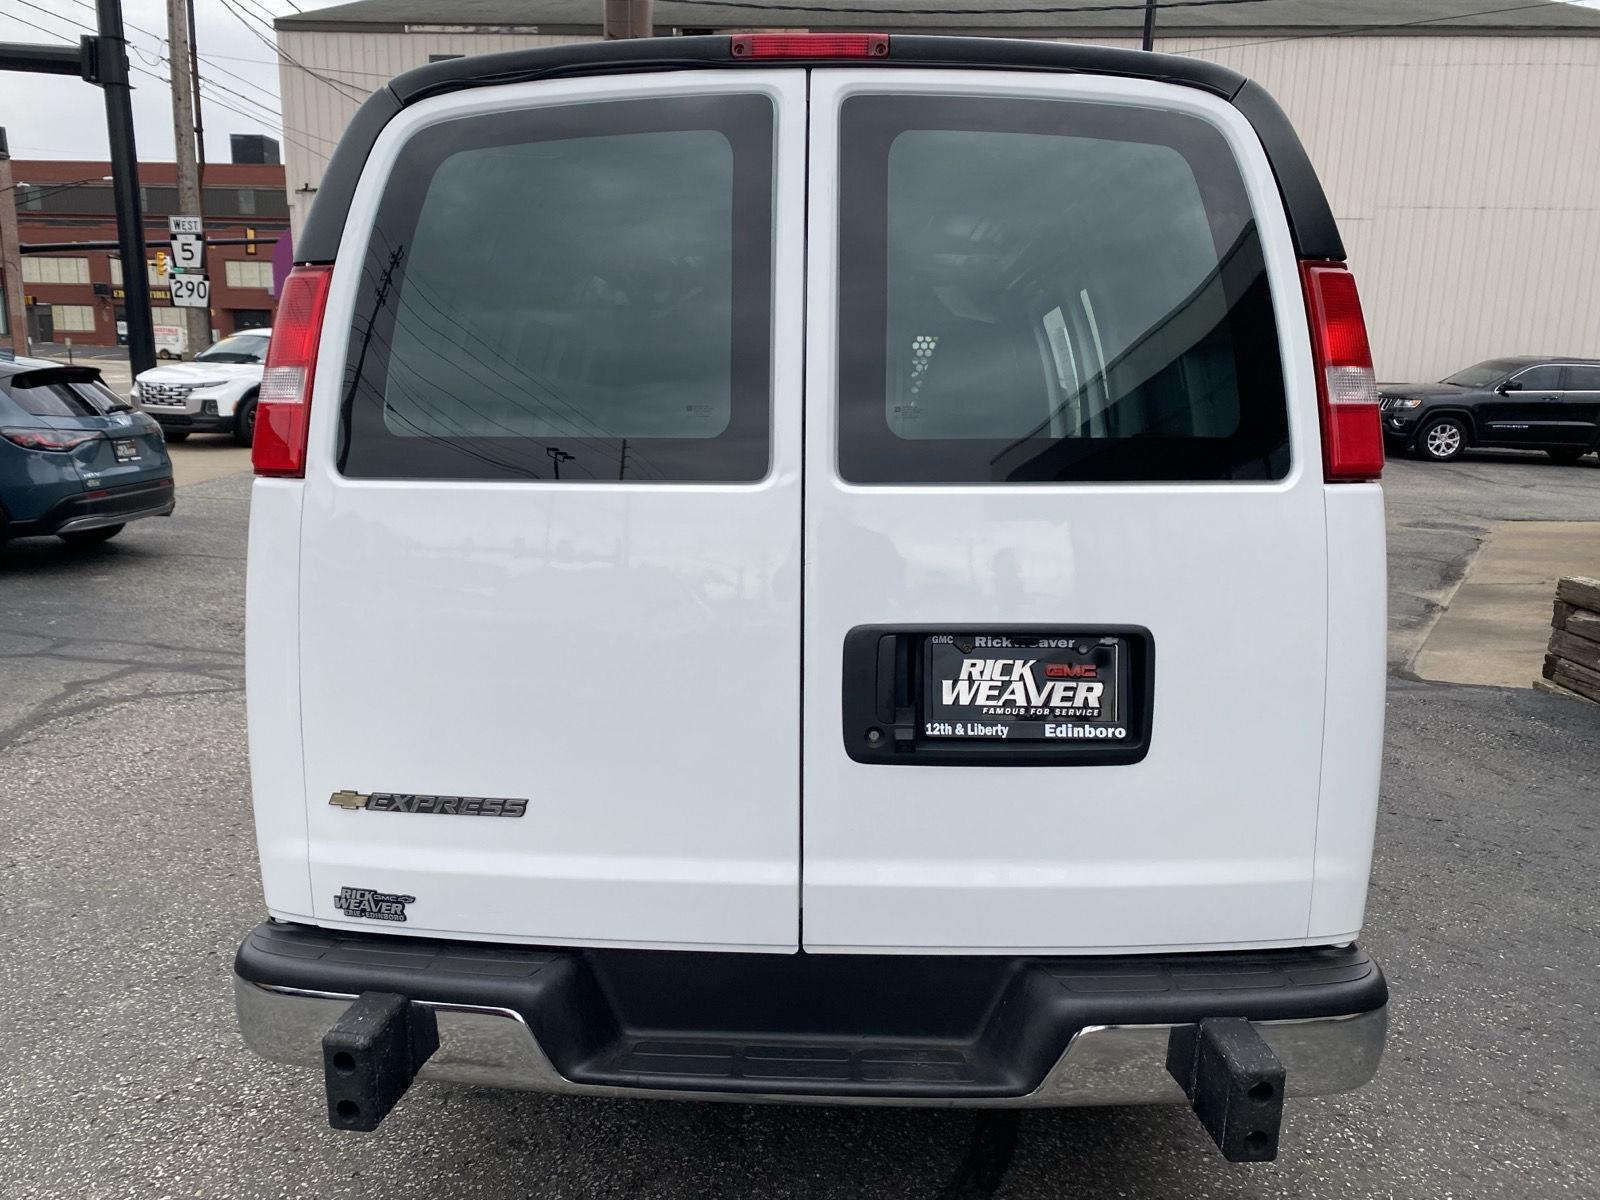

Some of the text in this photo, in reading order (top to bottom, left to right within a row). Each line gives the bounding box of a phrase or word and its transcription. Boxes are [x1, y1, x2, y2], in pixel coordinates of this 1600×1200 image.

[173, 220, 198, 231] WEST
[181, 242, 194, 260] 5
[174, 280, 207, 299] 290
[932, 635, 954, 644] GMC
[975, 637, 1076, 648] Rick aver
[959, 659, 1037, 680] RICK
[1045, 664, 1097, 677] GMC
[942, 680, 1105, 708] WEAVER
[982, 707, 1100, 717] FAMOUS FOR SERVICE
[925, 723, 1009, 738] 12th & Liberty
[1045, 724, 1127, 738] Edinboro
[367, 792, 529, 817] EXPRESS
[341, 888, 375, 901] RICK
[373, 894, 397, 902] GMC
[334, 897, 403, 915] WEAVER
